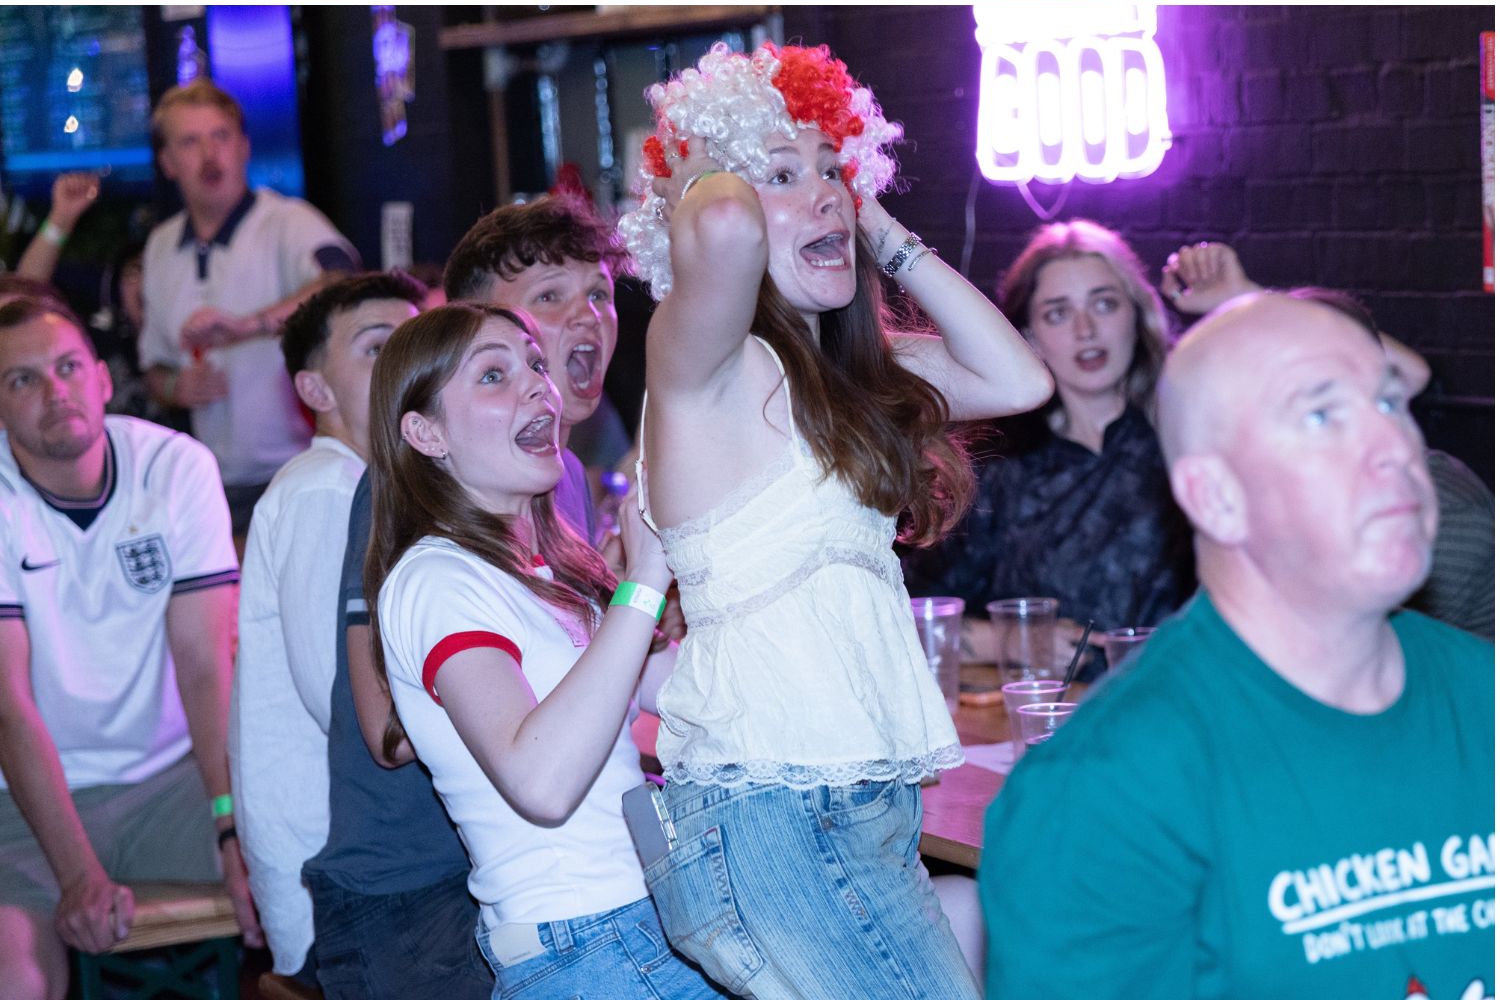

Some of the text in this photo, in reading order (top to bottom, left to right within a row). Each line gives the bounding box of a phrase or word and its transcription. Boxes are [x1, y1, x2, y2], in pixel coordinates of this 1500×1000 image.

[1268, 841, 1431, 922] CHICKEN
[1302, 920, 1365, 964] DON'T
[1406, 910, 1428, 940] AT
[1431, 903, 1470, 935] THE
